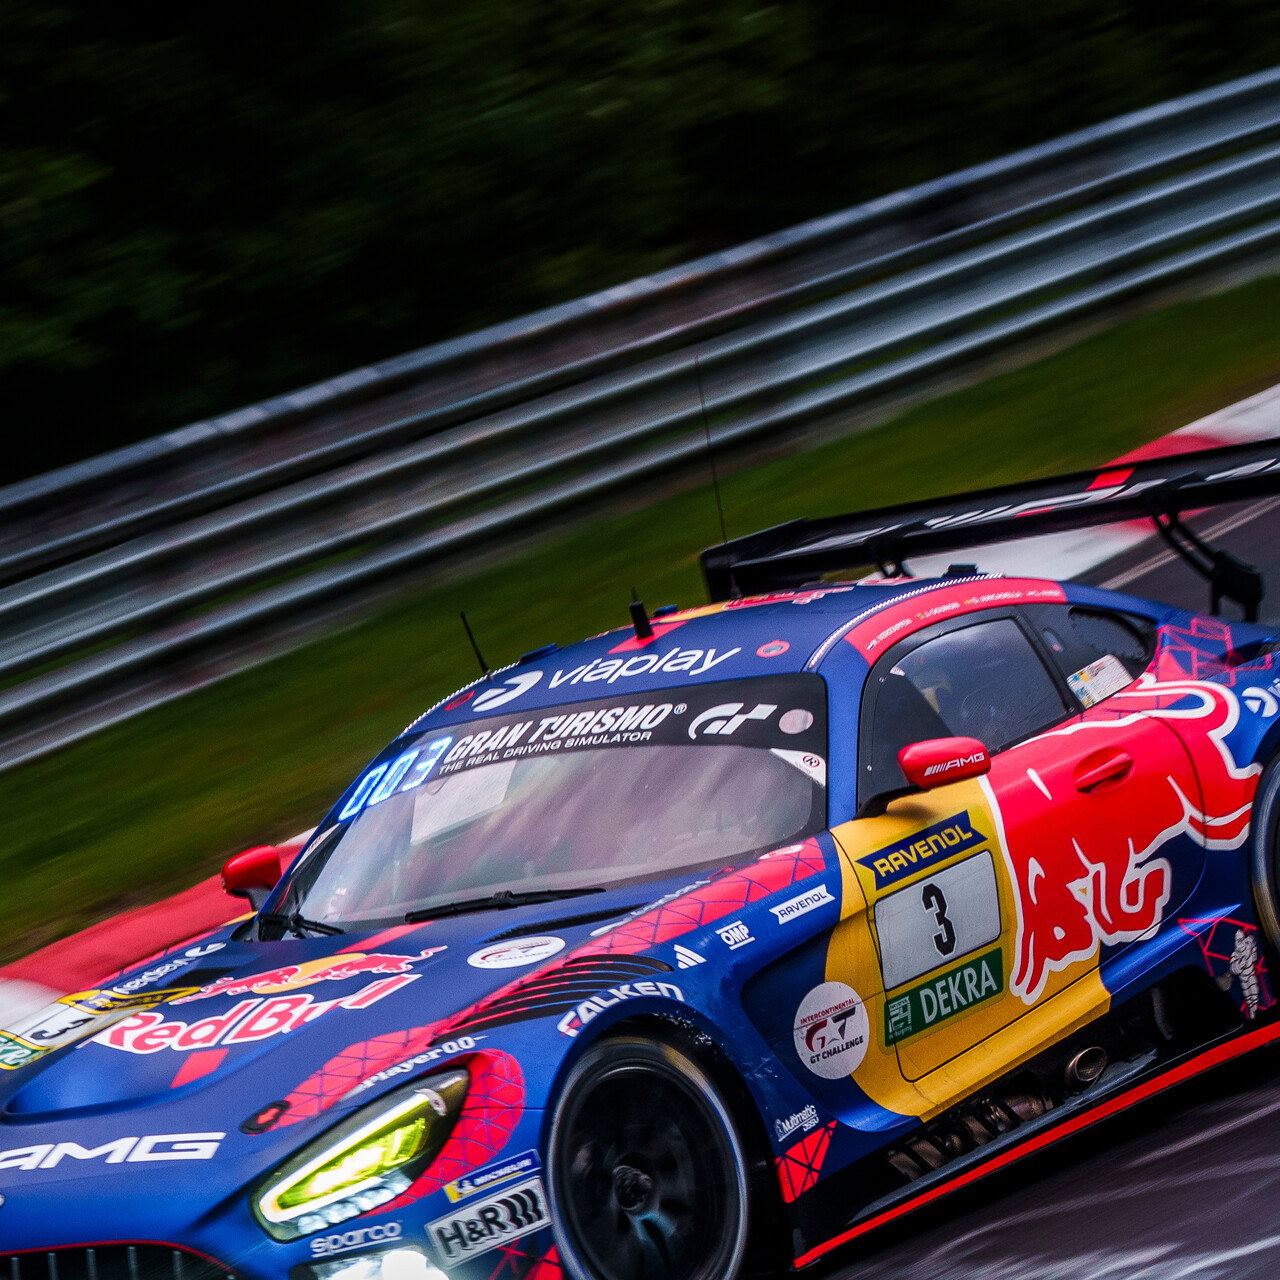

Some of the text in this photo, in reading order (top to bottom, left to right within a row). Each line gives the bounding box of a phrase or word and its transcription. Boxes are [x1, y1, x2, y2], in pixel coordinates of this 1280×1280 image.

[548, 646, 742, 690] viaplay
[438, 730, 652, 777] THE REAL DRIVING SIMULATOR
[443, 720, 535, 766] GRAN
[873, 824, 973, 877] RAVENOL
[778, 891, 827, 918] RAVENOL
[921, 882, 957, 957] 3
[720, 923, 750, 946] OMP
[556, 981, 686, 1037] FALKEN
[800, 997, 855, 1025] INTERCONTINENTAL
[919, 959, 998, 1024] DEKRA
[30, 1016, 96, 1041] 3
[94, 998, 267, 1054] Red
[809, 1035, 864, 1064] GT CHALLENGE
[780, 1104, 817, 1134] Multimatic
[310, 1222, 402, 1254] sparco
[436, 1206, 507, 1256] H&R
